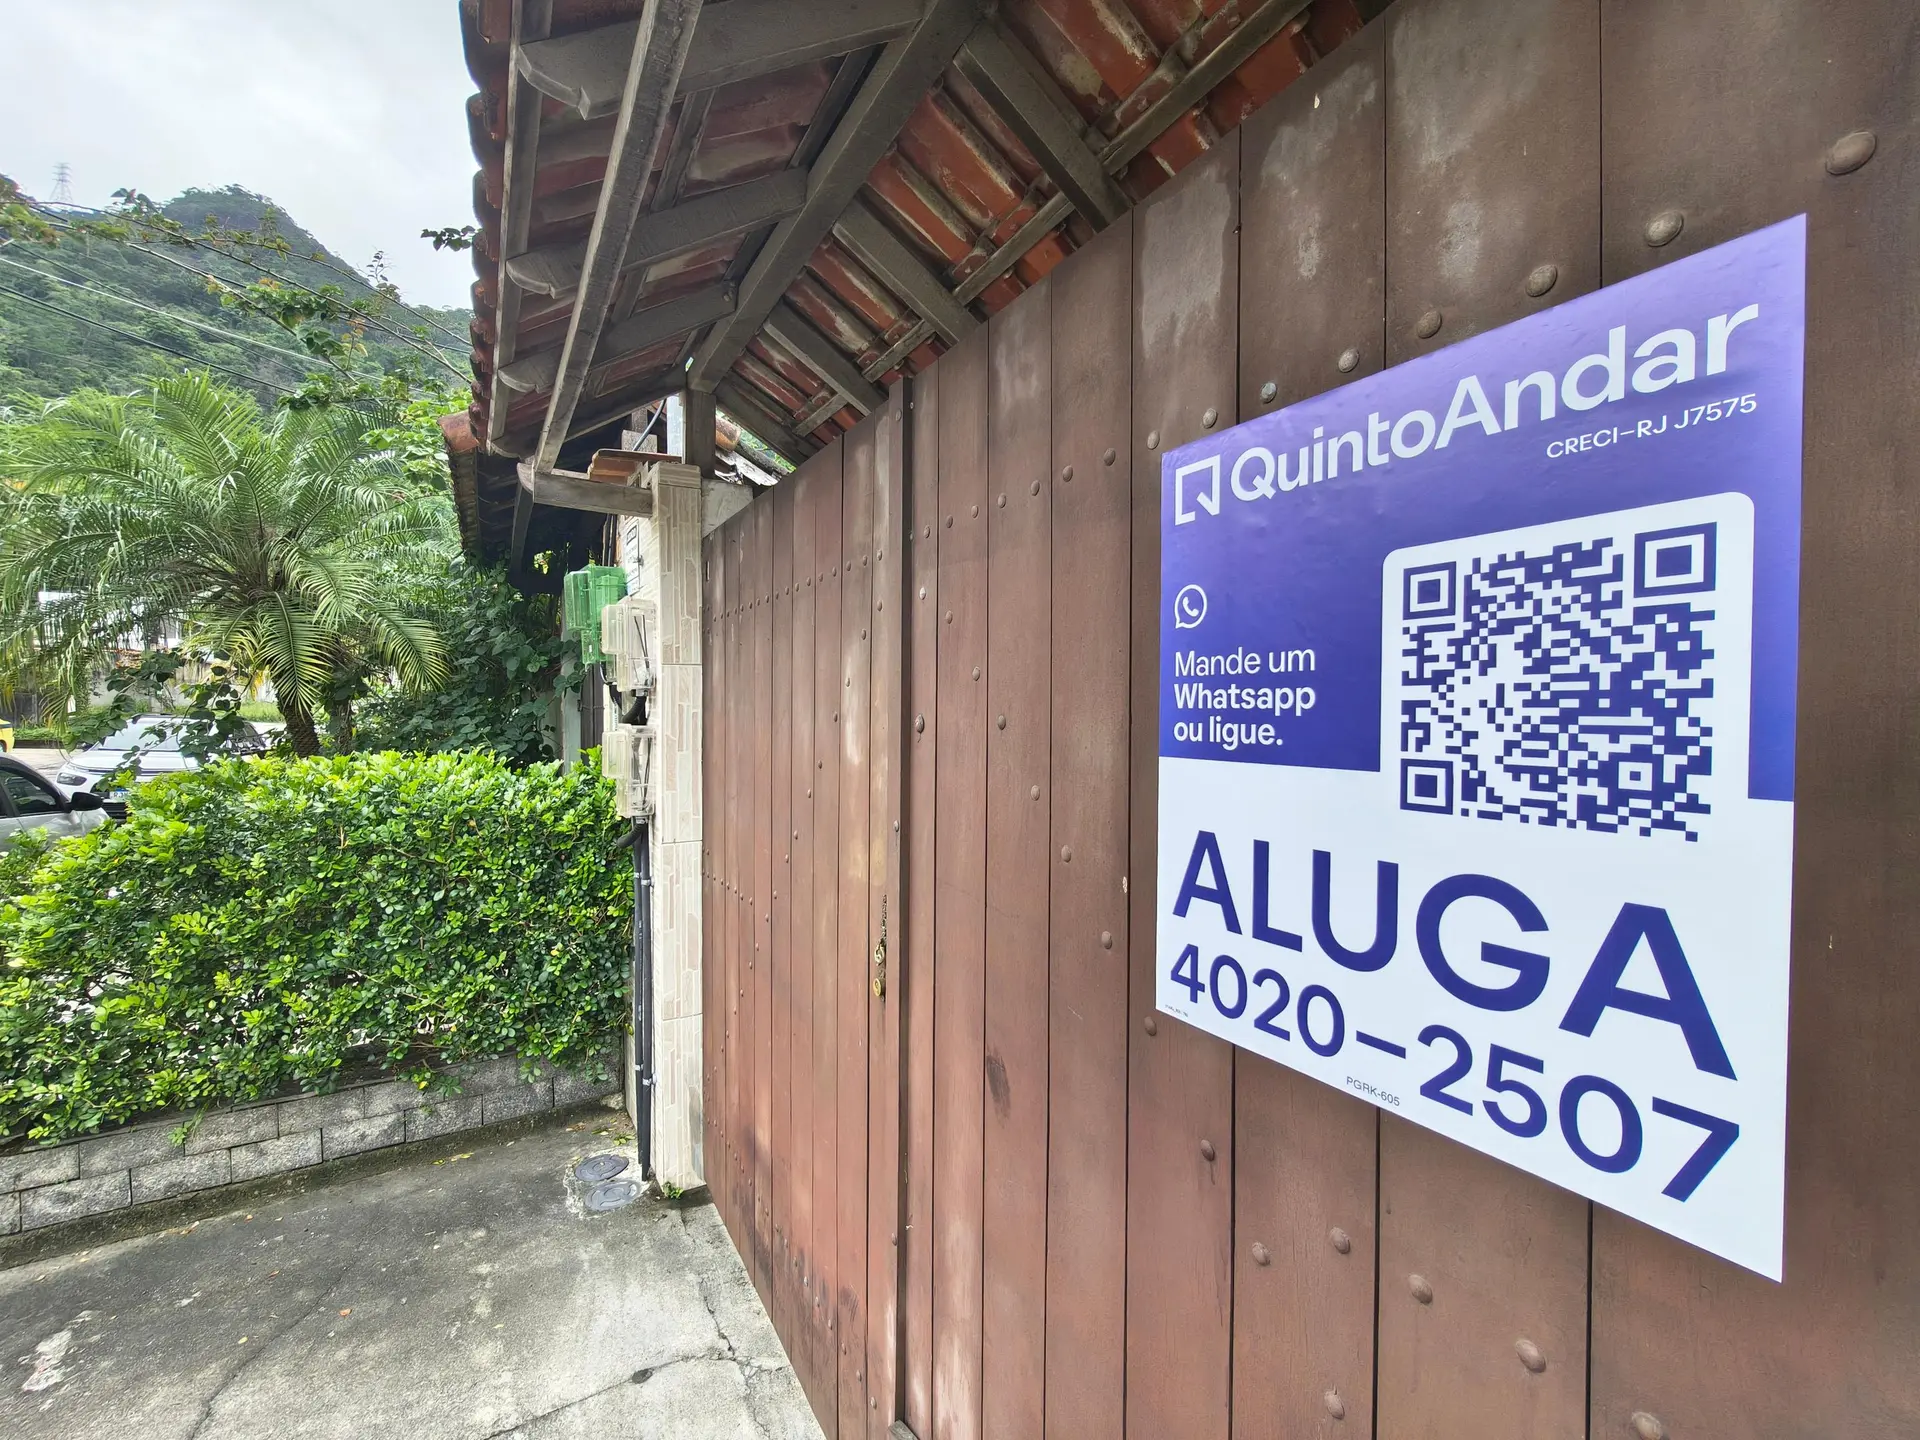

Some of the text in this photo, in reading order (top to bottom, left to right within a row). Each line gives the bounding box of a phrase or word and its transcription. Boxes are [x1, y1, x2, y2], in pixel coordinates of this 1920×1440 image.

[1230, 303, 1759, 501] QuintoAndar
[1673, 392, 1758, 429] J7575
[1174, 647, 1316, 677] Mande um
[1174, 682, 1316, 718] Whatsapp
[1173, 715, 1283, 751] ou ligue.
[1172, 830, 1738, 1081] ALUGA
[1170, 943, 1740, 1203] 4020-2507
[1346, 1076, 1400, 1106] PGRK-605
